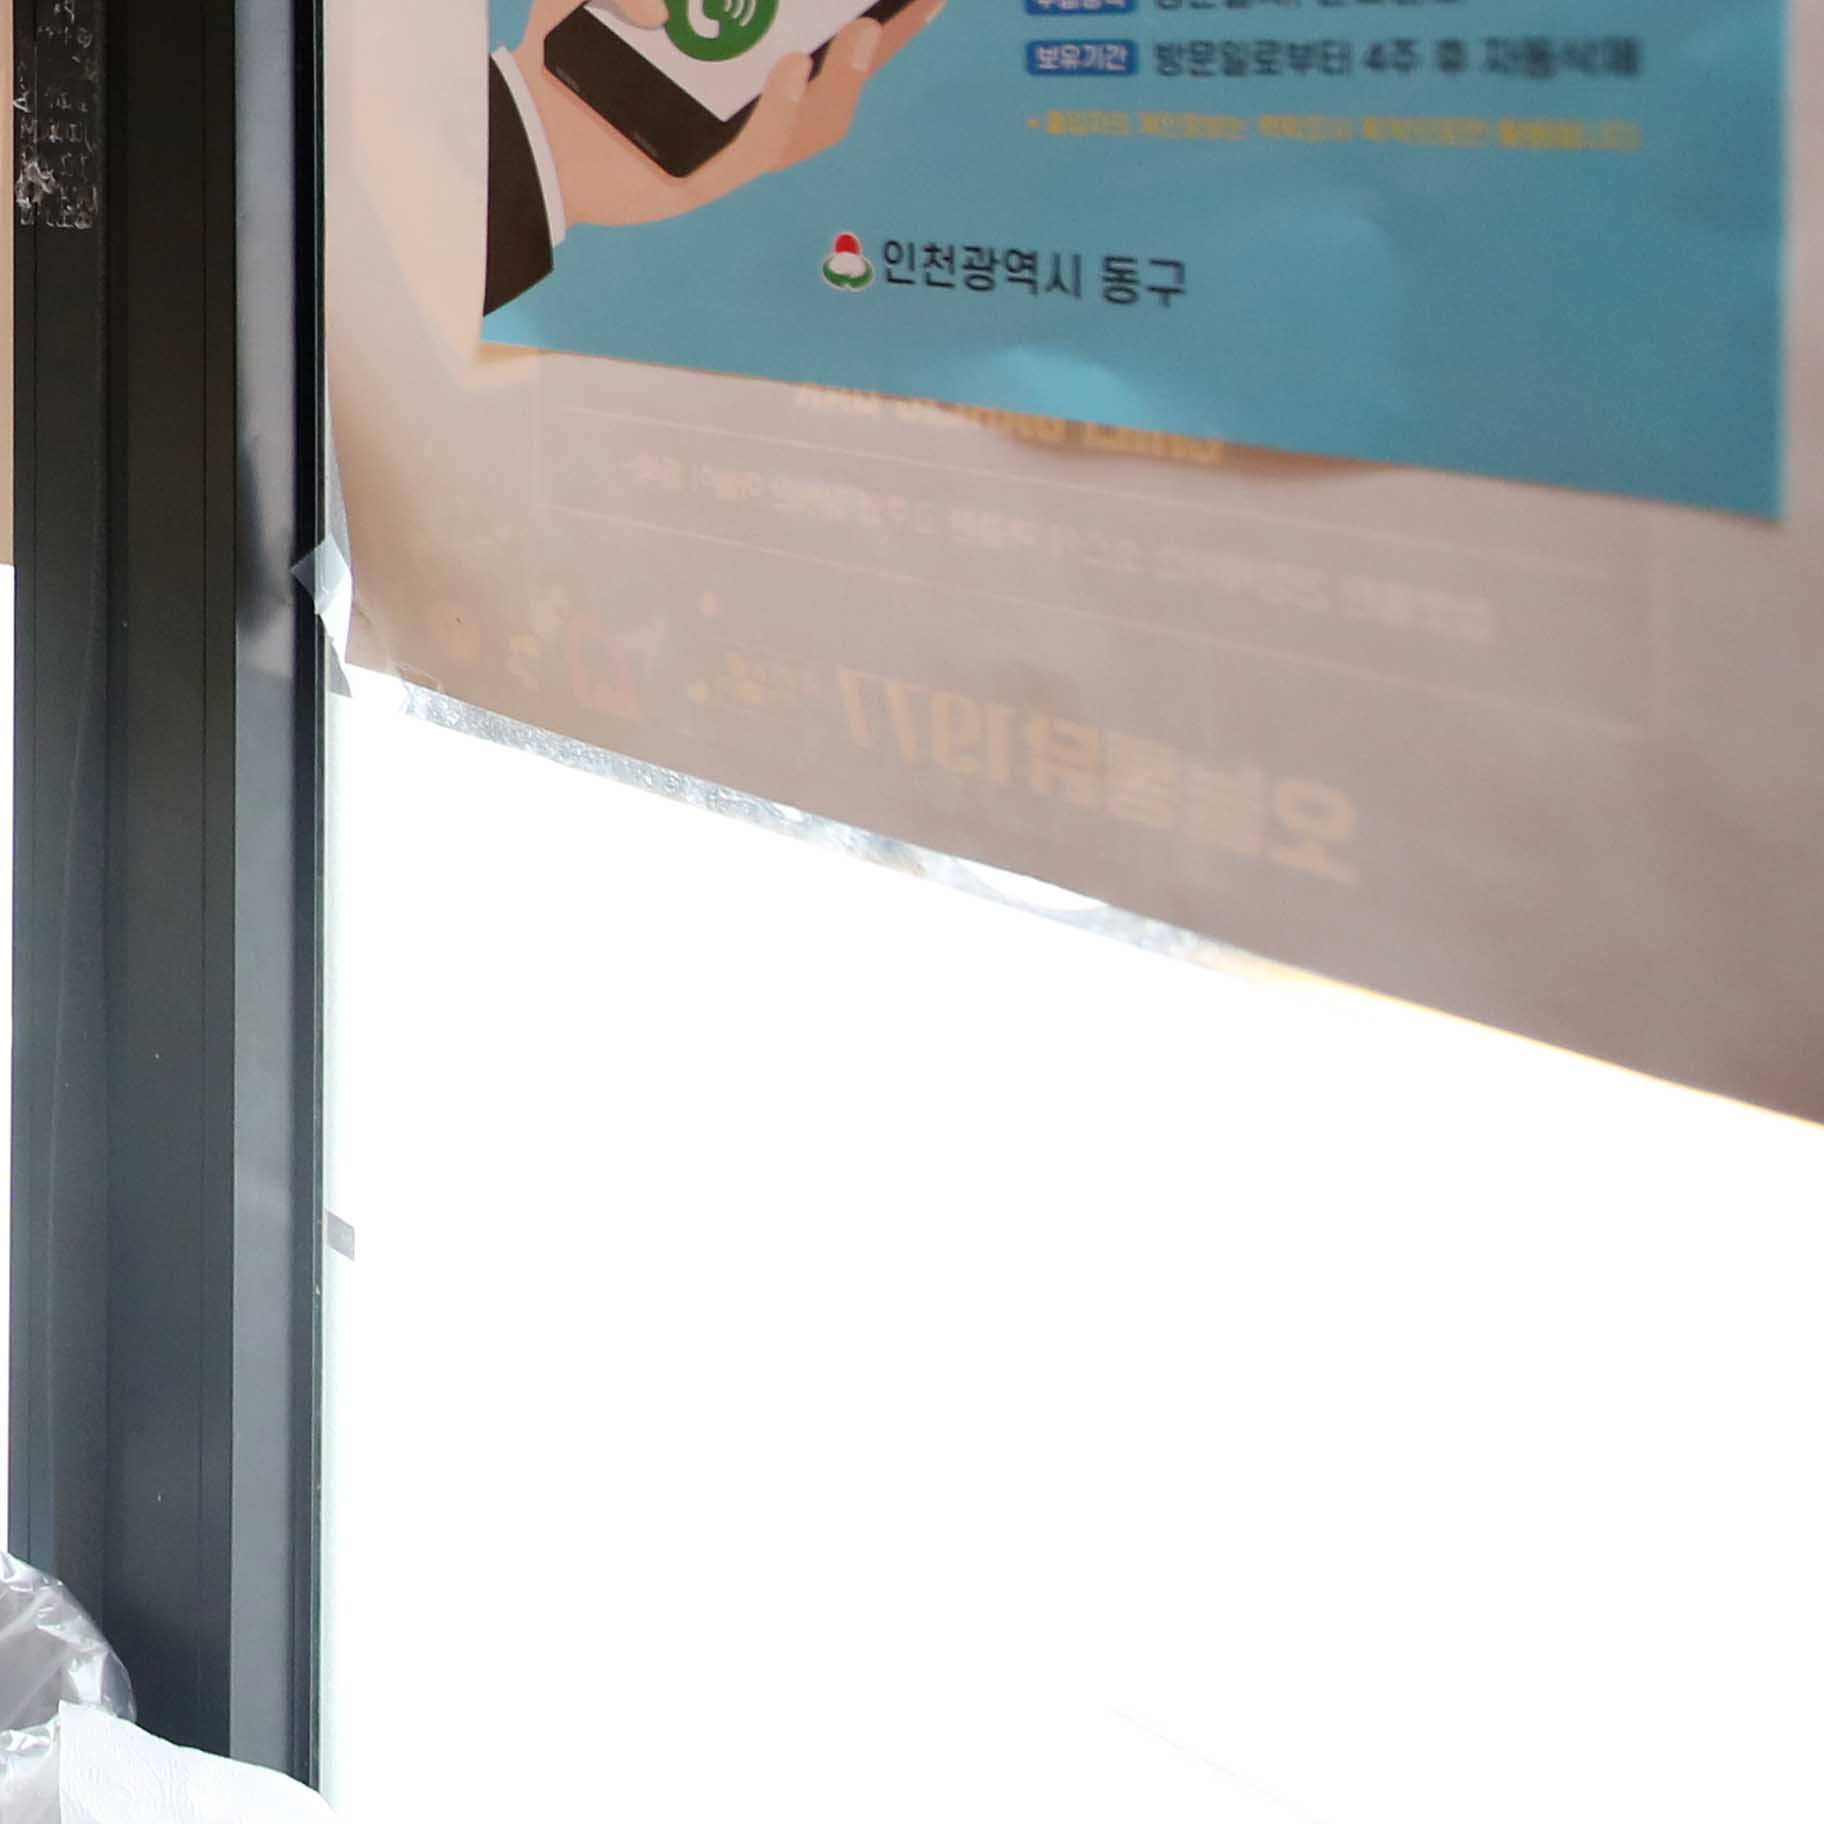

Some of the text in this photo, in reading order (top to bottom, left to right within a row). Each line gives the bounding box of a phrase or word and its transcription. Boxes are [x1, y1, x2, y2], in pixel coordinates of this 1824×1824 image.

[1035, 44, 1127, 72] 보유기간
[883, 238, 1185, 307] 인천광역시 동구
